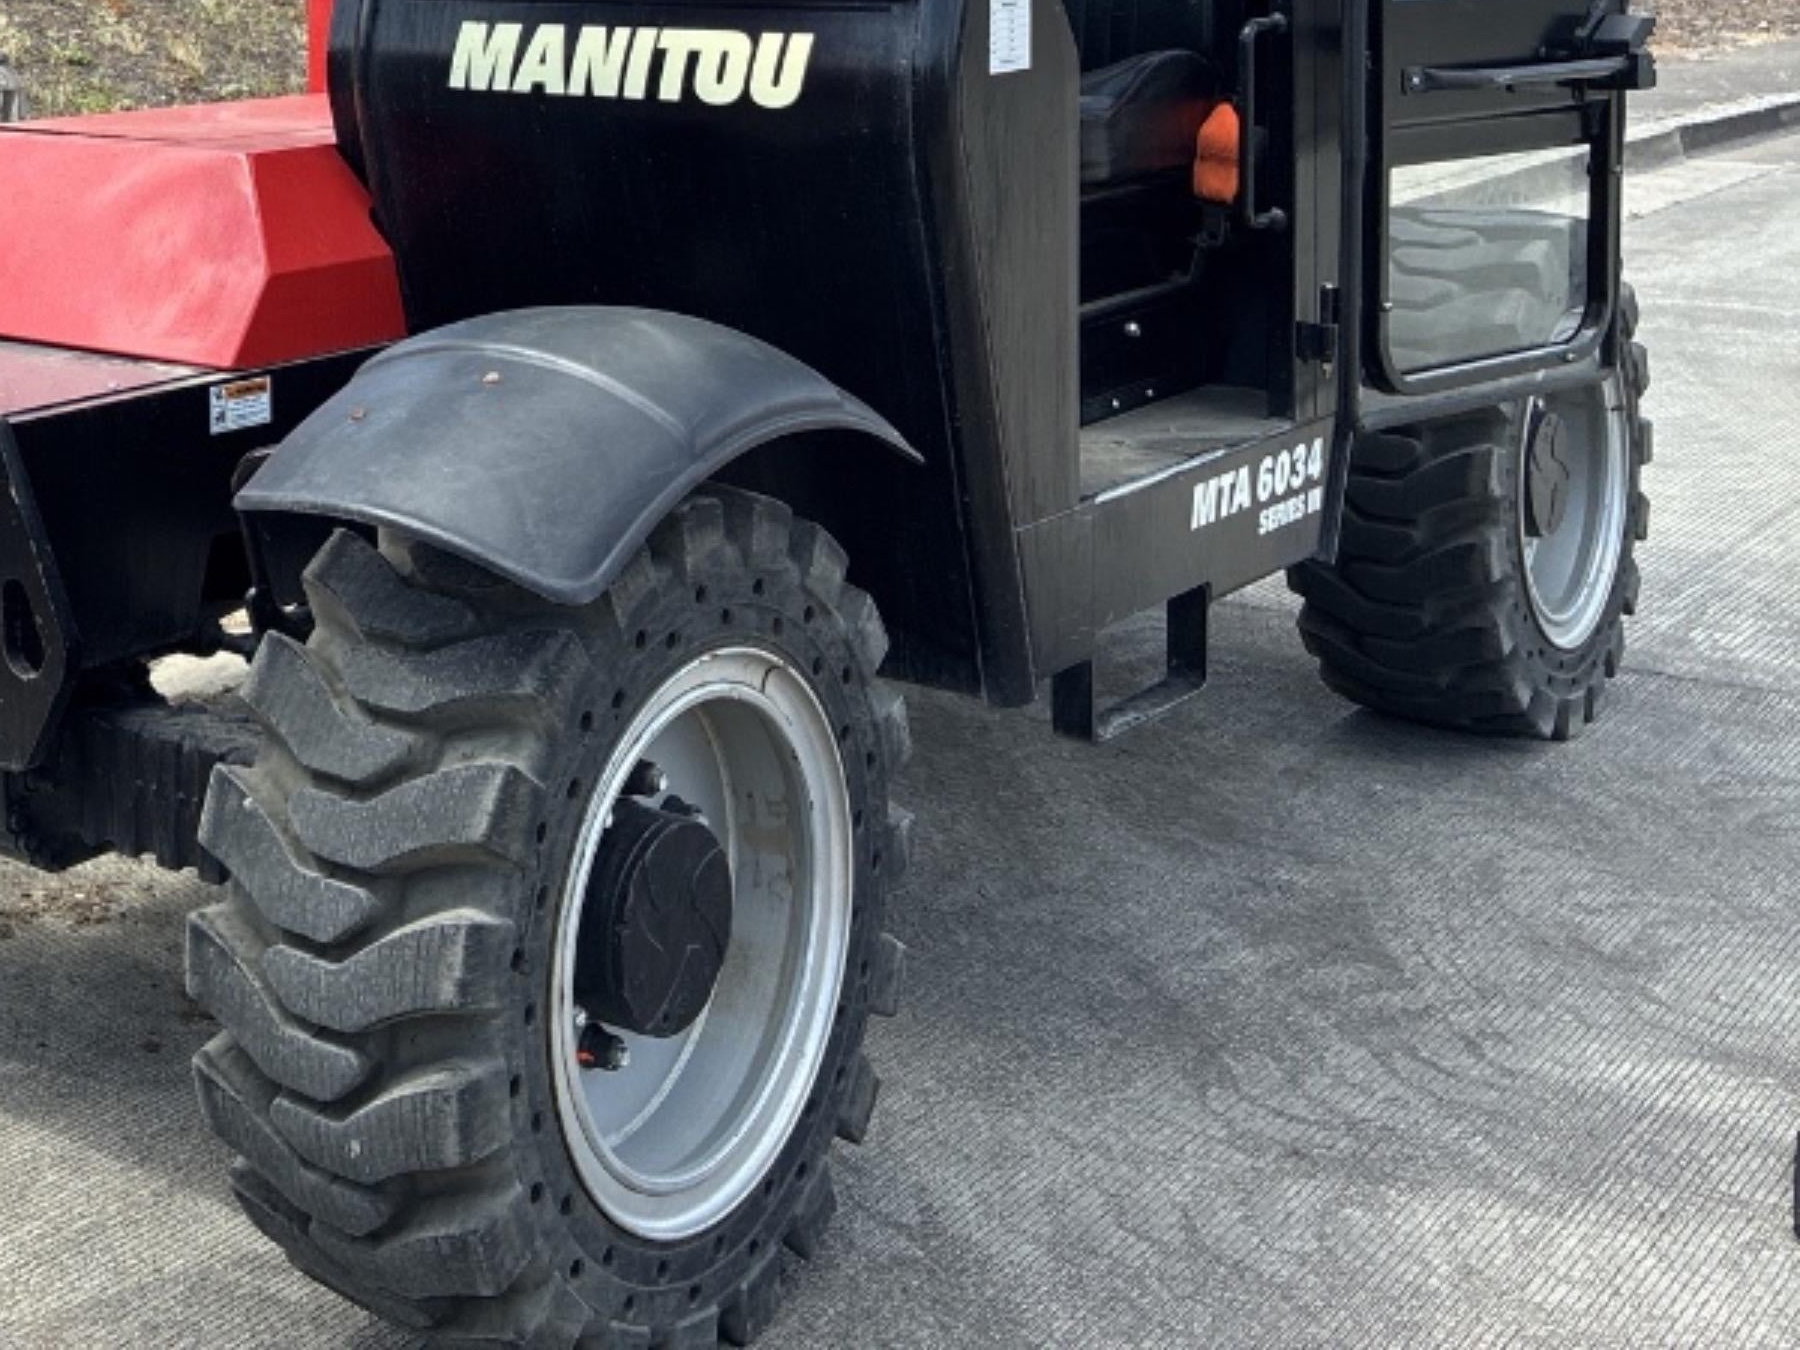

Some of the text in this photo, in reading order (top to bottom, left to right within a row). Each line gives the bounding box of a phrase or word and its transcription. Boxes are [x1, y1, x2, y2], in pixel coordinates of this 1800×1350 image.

[448, 20, 815, 109] MANITOU
[1190, 437, 1324, 531] MTA 6034
[1257, 493, 1306, 536] SERIES
